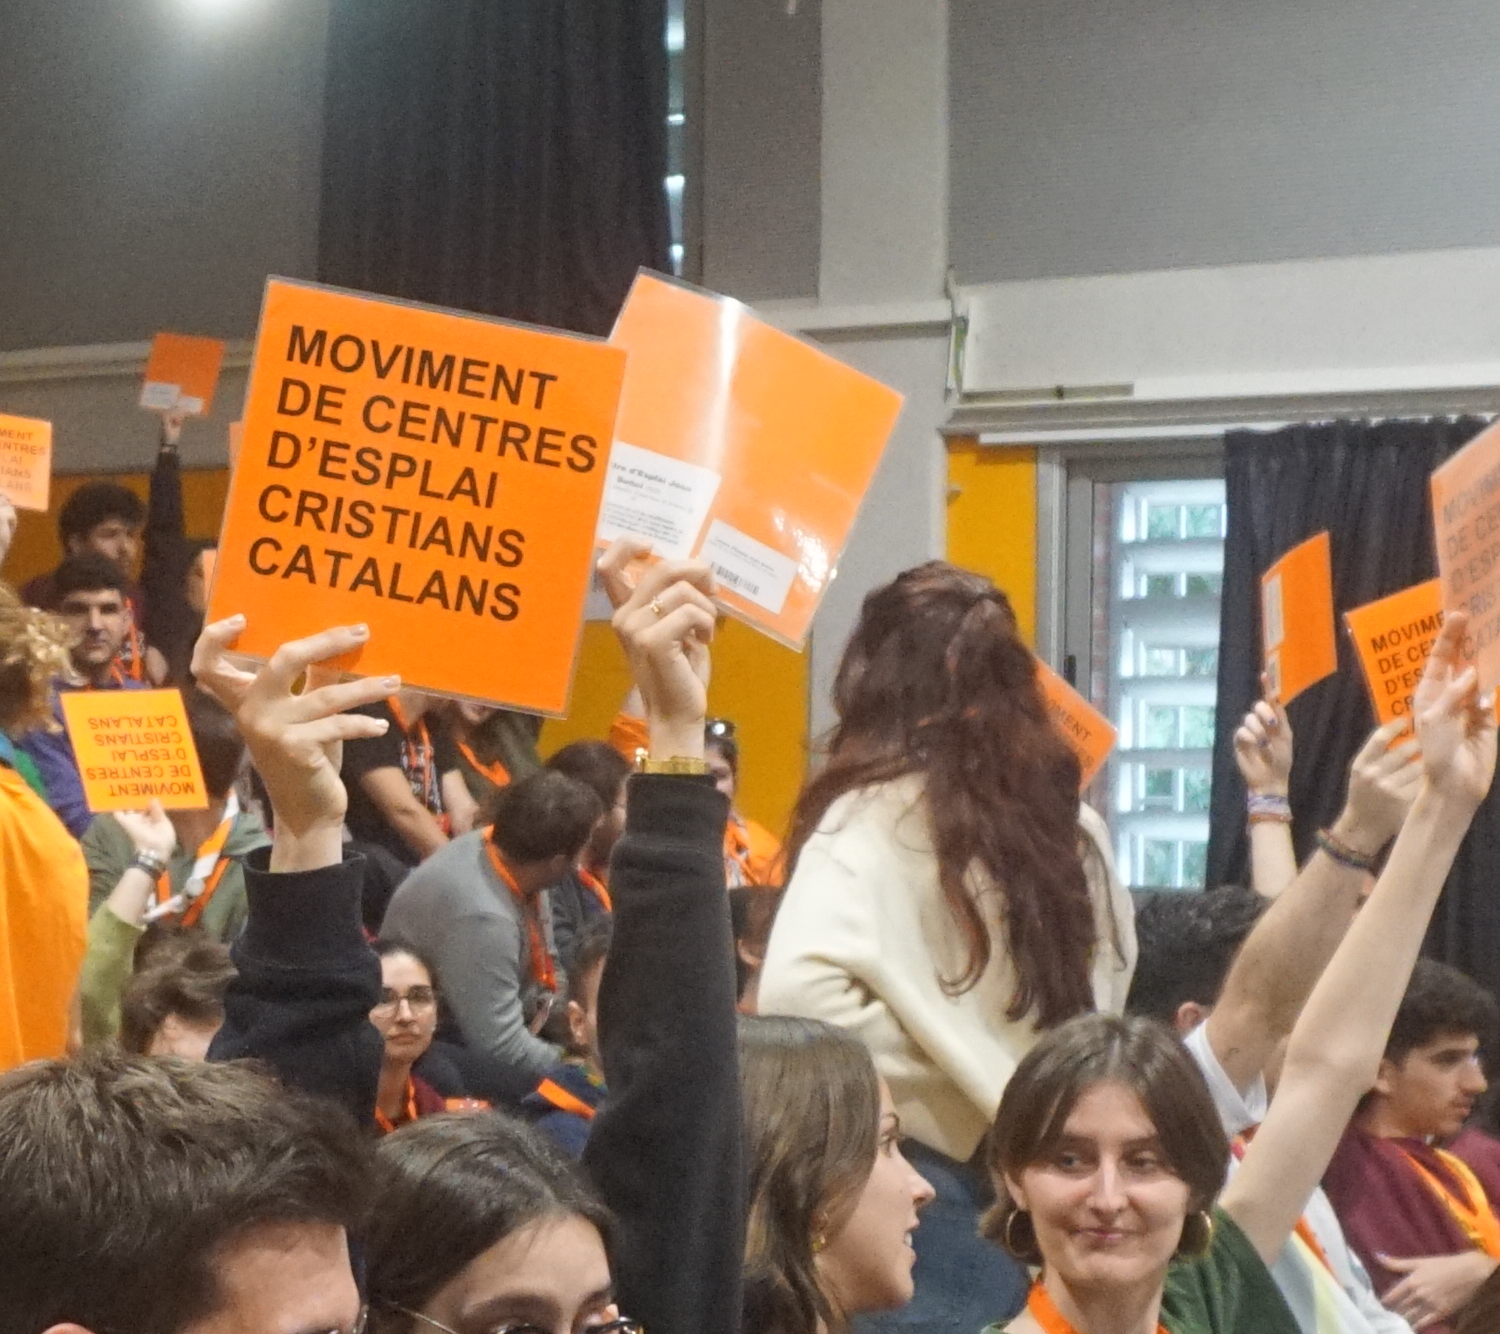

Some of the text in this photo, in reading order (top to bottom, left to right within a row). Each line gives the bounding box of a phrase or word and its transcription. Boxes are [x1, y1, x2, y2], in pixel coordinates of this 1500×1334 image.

[286, 324, 558, 410] MOVIMENT
[277, 377, 598, 474] DE CENTRES
[258, 484, 526, 568] CRISTIANS
[249, 537, 522, 621] CATALANS
[1378, 652, 1403, 675] DE
[88, 715, 178, 730] CATALANS
[94, 731, 183, 747] CRISTIANS
[86, 765, 191, 781] DE CENTRES
[109, 782, 196, 797] MOVIMENT
